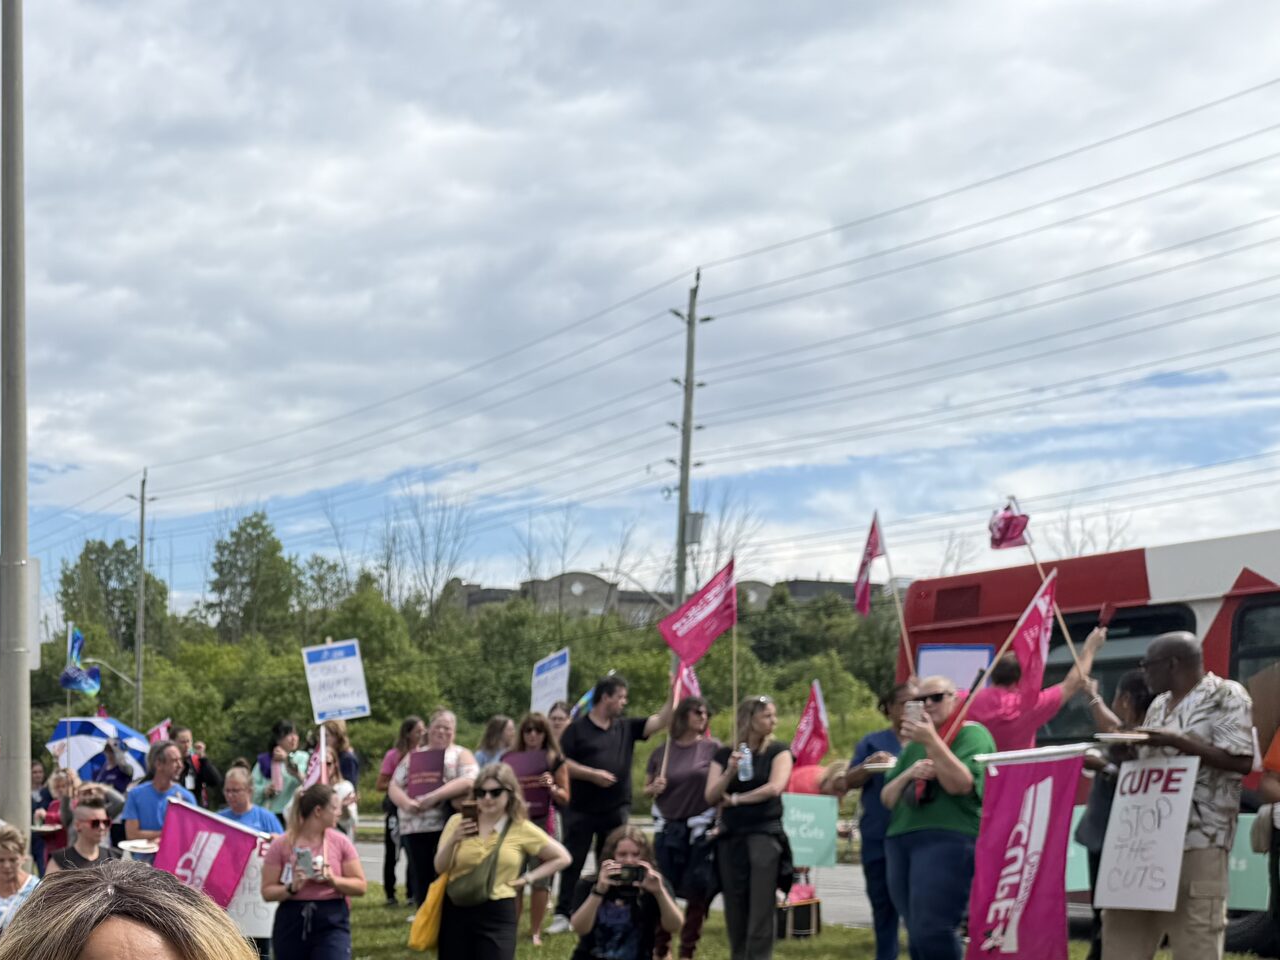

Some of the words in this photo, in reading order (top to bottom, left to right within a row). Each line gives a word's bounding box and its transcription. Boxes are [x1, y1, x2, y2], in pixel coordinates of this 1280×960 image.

[1118, 767, 1187, 796] CUPE
[1117, 796, 1173, 842] STOP
[1114, 840, 1156, 863] THE
[1107, 866, 1166, 892] CUTS
